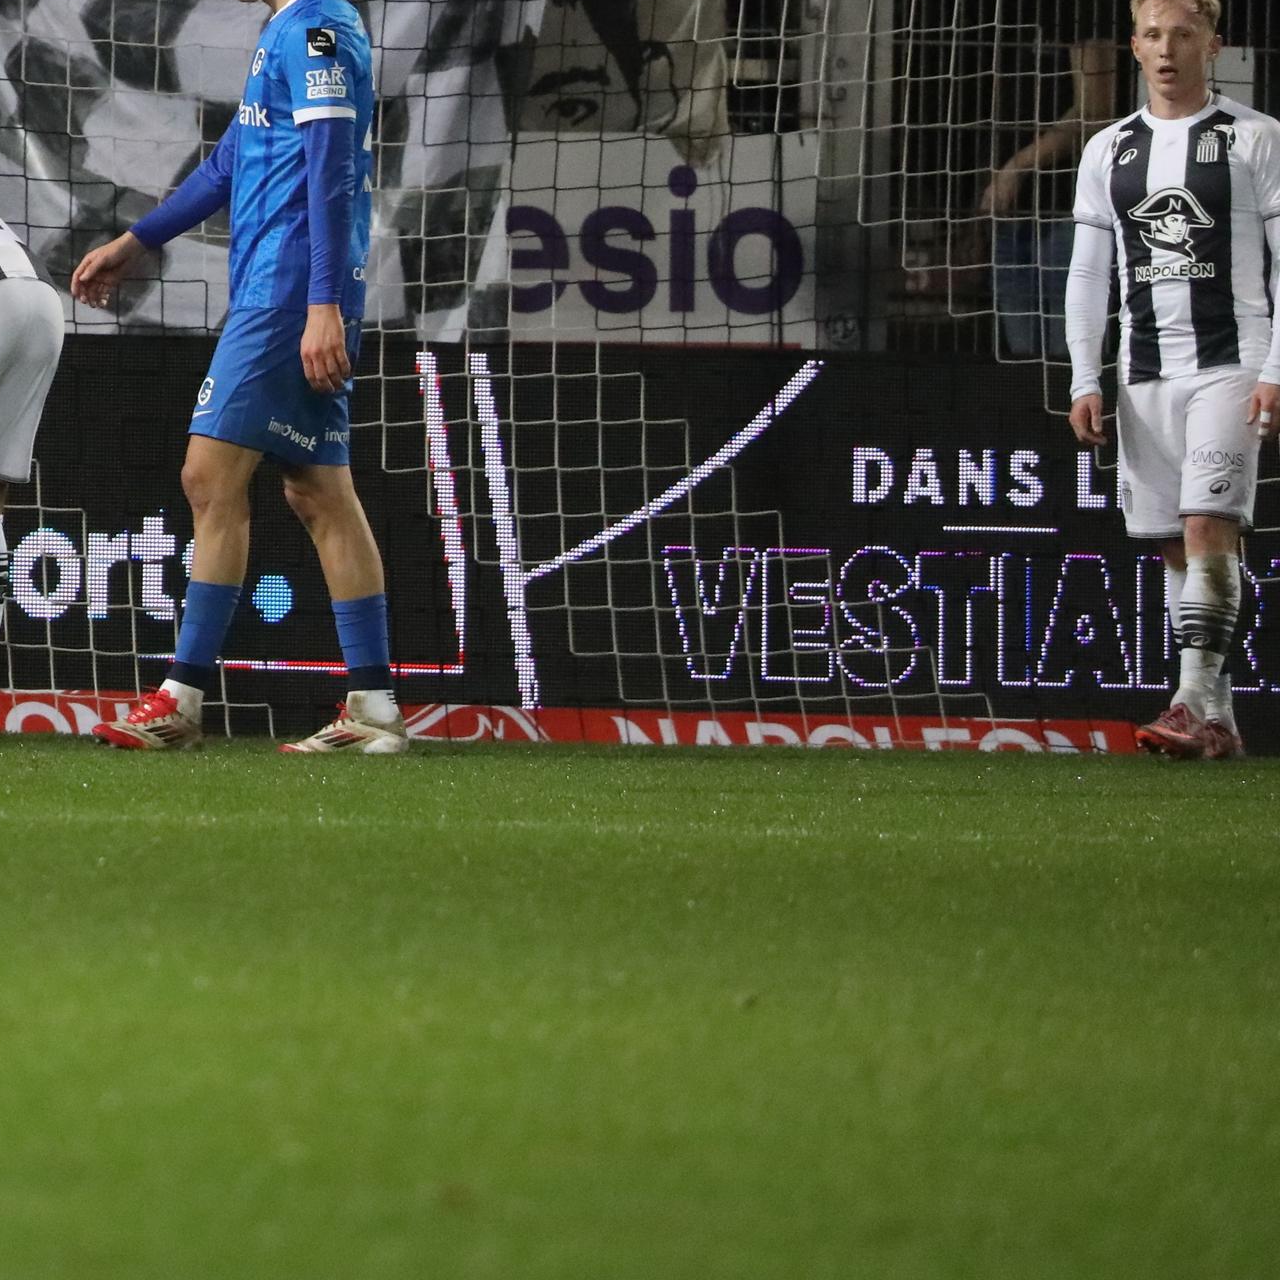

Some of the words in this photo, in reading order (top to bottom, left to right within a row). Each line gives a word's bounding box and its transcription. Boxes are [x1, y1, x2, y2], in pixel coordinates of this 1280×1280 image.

[305, 67, 345, 87] STAR
[309, 87, 344, 97] CASINO
[505, 165, 803, 315] esio
[1134, 261, 1215, 283] NAPOLEON
[852, 446, 1044, 508] DANS
[1076, 451, 1123, 509] L
